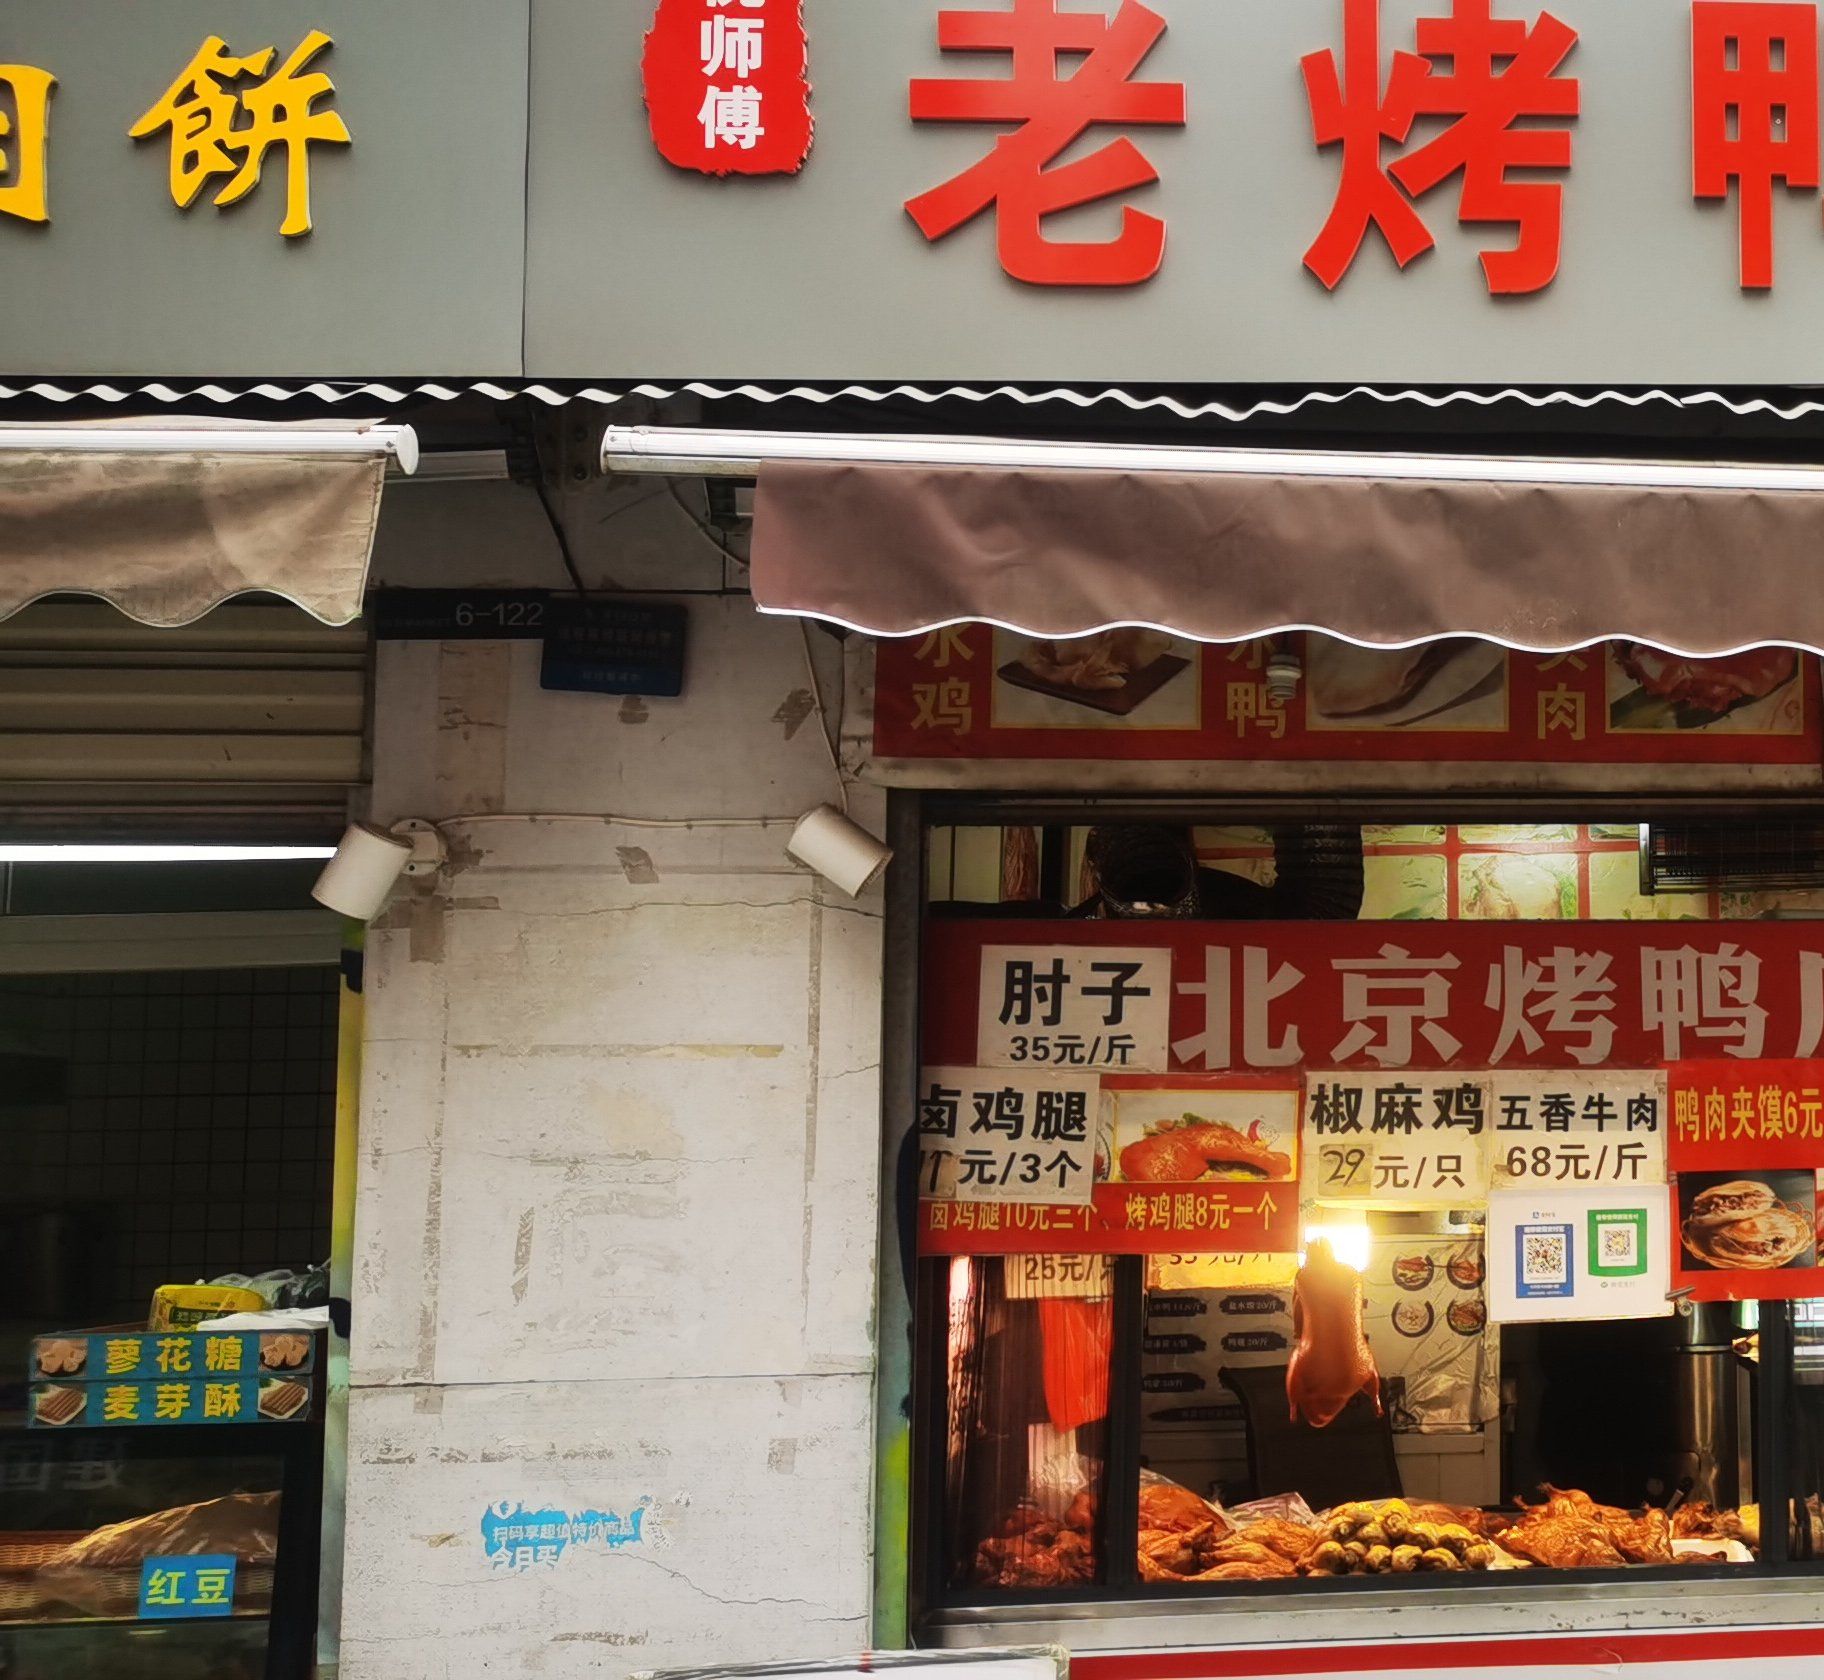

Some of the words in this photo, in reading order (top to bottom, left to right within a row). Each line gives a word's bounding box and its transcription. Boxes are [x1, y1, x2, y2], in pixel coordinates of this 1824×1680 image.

[696, 0, 765, 150] 师傅
[455, 602, 544, 627] 6-122
[998, 957, 1151, 1027] 肘子
[1009, 1034, 1136, 1066] 35元/斤
[920, 1083, 1087, 1142] 卤鸡腿
[1310, 1082, 1484, 1136] 椒麻鸡
[1498, 1095, 1658, 1132] 五香牛肉
[1674, 1083, 1824, 1142] 鸭肉夹馍6元
[1506, 1141, 1648, 1180] 68元/斤
[105, 1335, 243, 1374] 蓼花糖
[104, 1383, 241, 1420] 麦芽酥
[145, 1567, 231, 1606] 红豆
